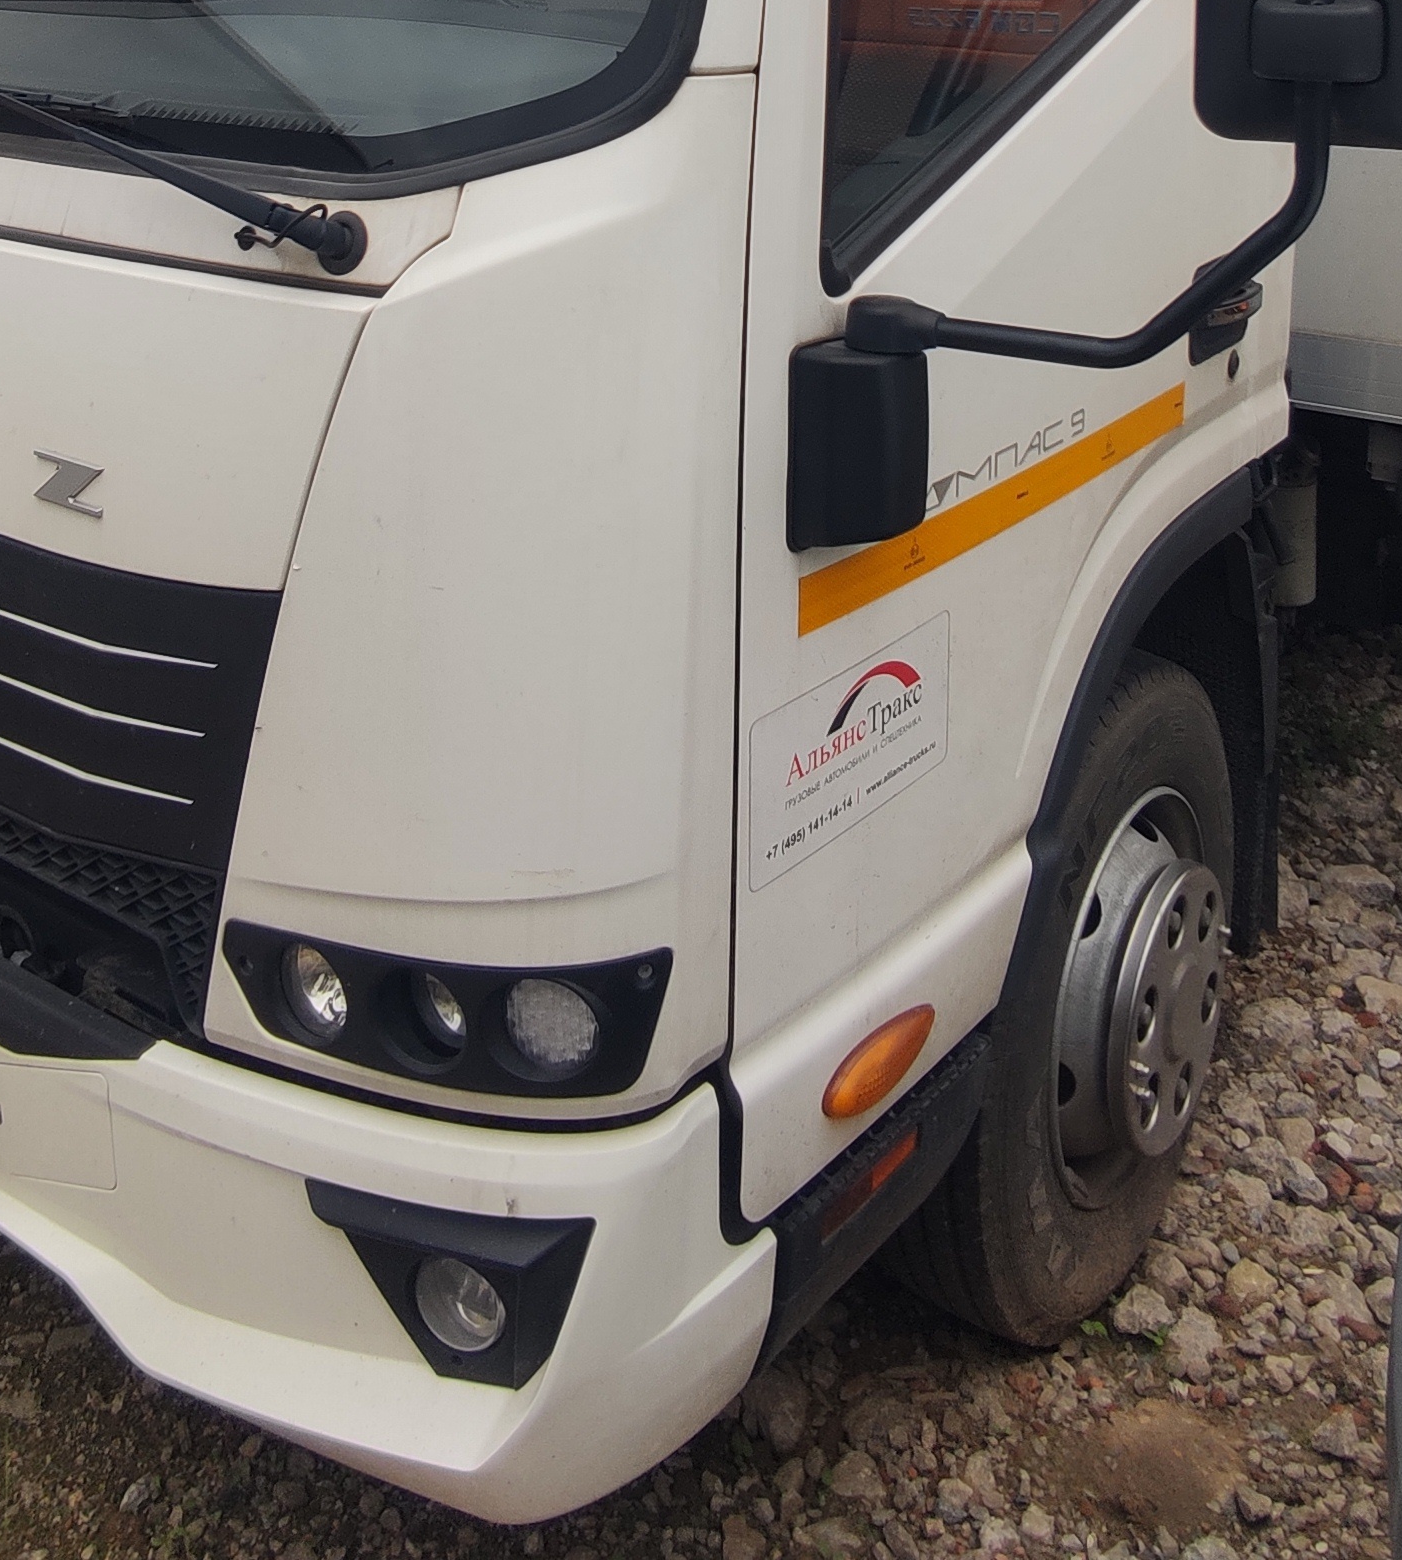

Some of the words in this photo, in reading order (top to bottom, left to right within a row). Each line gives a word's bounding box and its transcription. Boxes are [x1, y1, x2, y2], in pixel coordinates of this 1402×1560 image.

[1070, 408, 1085, 438] 9
[765, 843, 779, 861] +7
[781, 826, 806, 856] (495)
[808, 794, 853, 835] 141-14-14
[865, 740, 937, 795] www.alliance-trucks.ru
[784, 781, 821, 811] ГРУЗОВЫЕ
[823, 749, 870, 786] АВТОМОБИЛИ
[880, 714, 923, 749] СПЕЦТЕХНИКА
